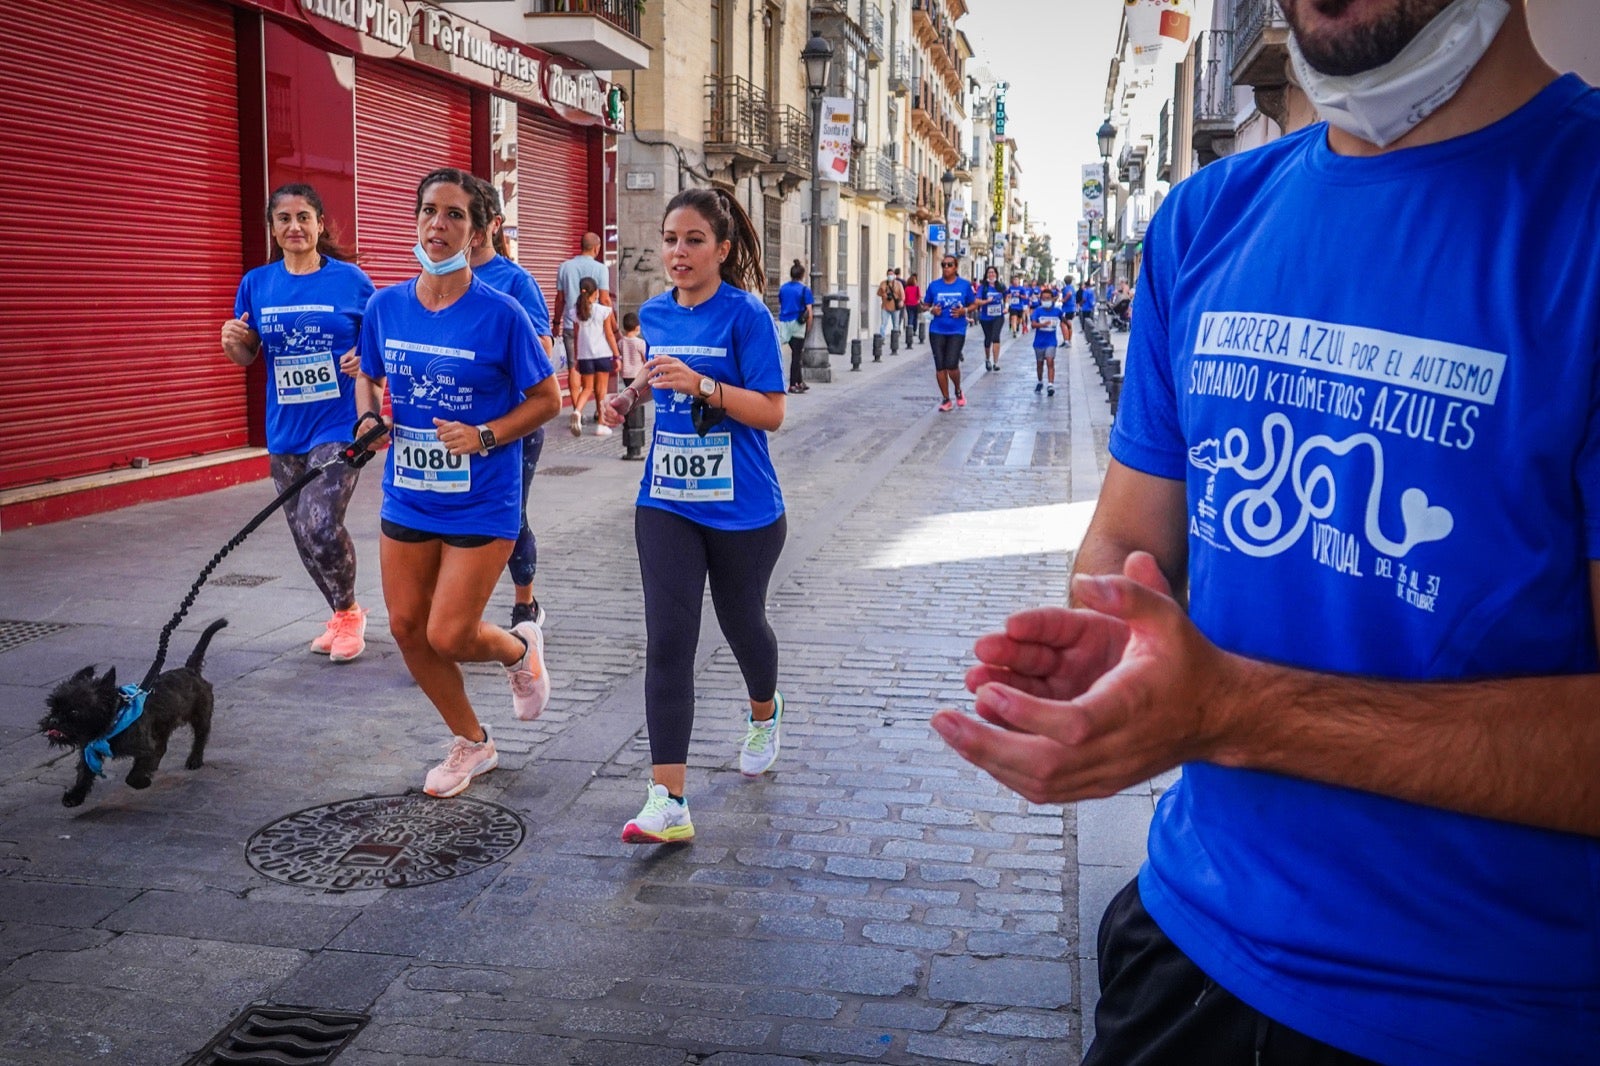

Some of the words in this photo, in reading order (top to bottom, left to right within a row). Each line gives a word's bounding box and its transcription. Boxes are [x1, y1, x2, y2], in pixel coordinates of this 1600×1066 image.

[357, 0, 411, 48] Pilar
[823, 123, 841, 136] Santa
[1201, 317, 1215, 348] V
[1217, 316, 1292, 356] CARRERA
[1298, 324, 1346, 366] AZUL
[1349, 341, 1380, 372] POR
[1384, 349, 1403, 377] EL
[1410, 354, 1494, 396] AUTISMO
[283, 367, 331, 387] 1086
[1188, 359, 1259, 402] SUMANDO
[1264, 368, 1366, 421] KILÓMETROS
[1369, 386, 1480, 450] AZULES
[403, 446, 462, 469] 1080
[662, 453, 724, 477] 1087
[1312, 520, 1363, 577] VIRTUAL
[1375, 557, 1393, 578] DEL
[1409, 569, 1419, 591] AL
[1426, 574, 1441, 597] 31
[1406, 587, 1437, 613] OCTUBRE
